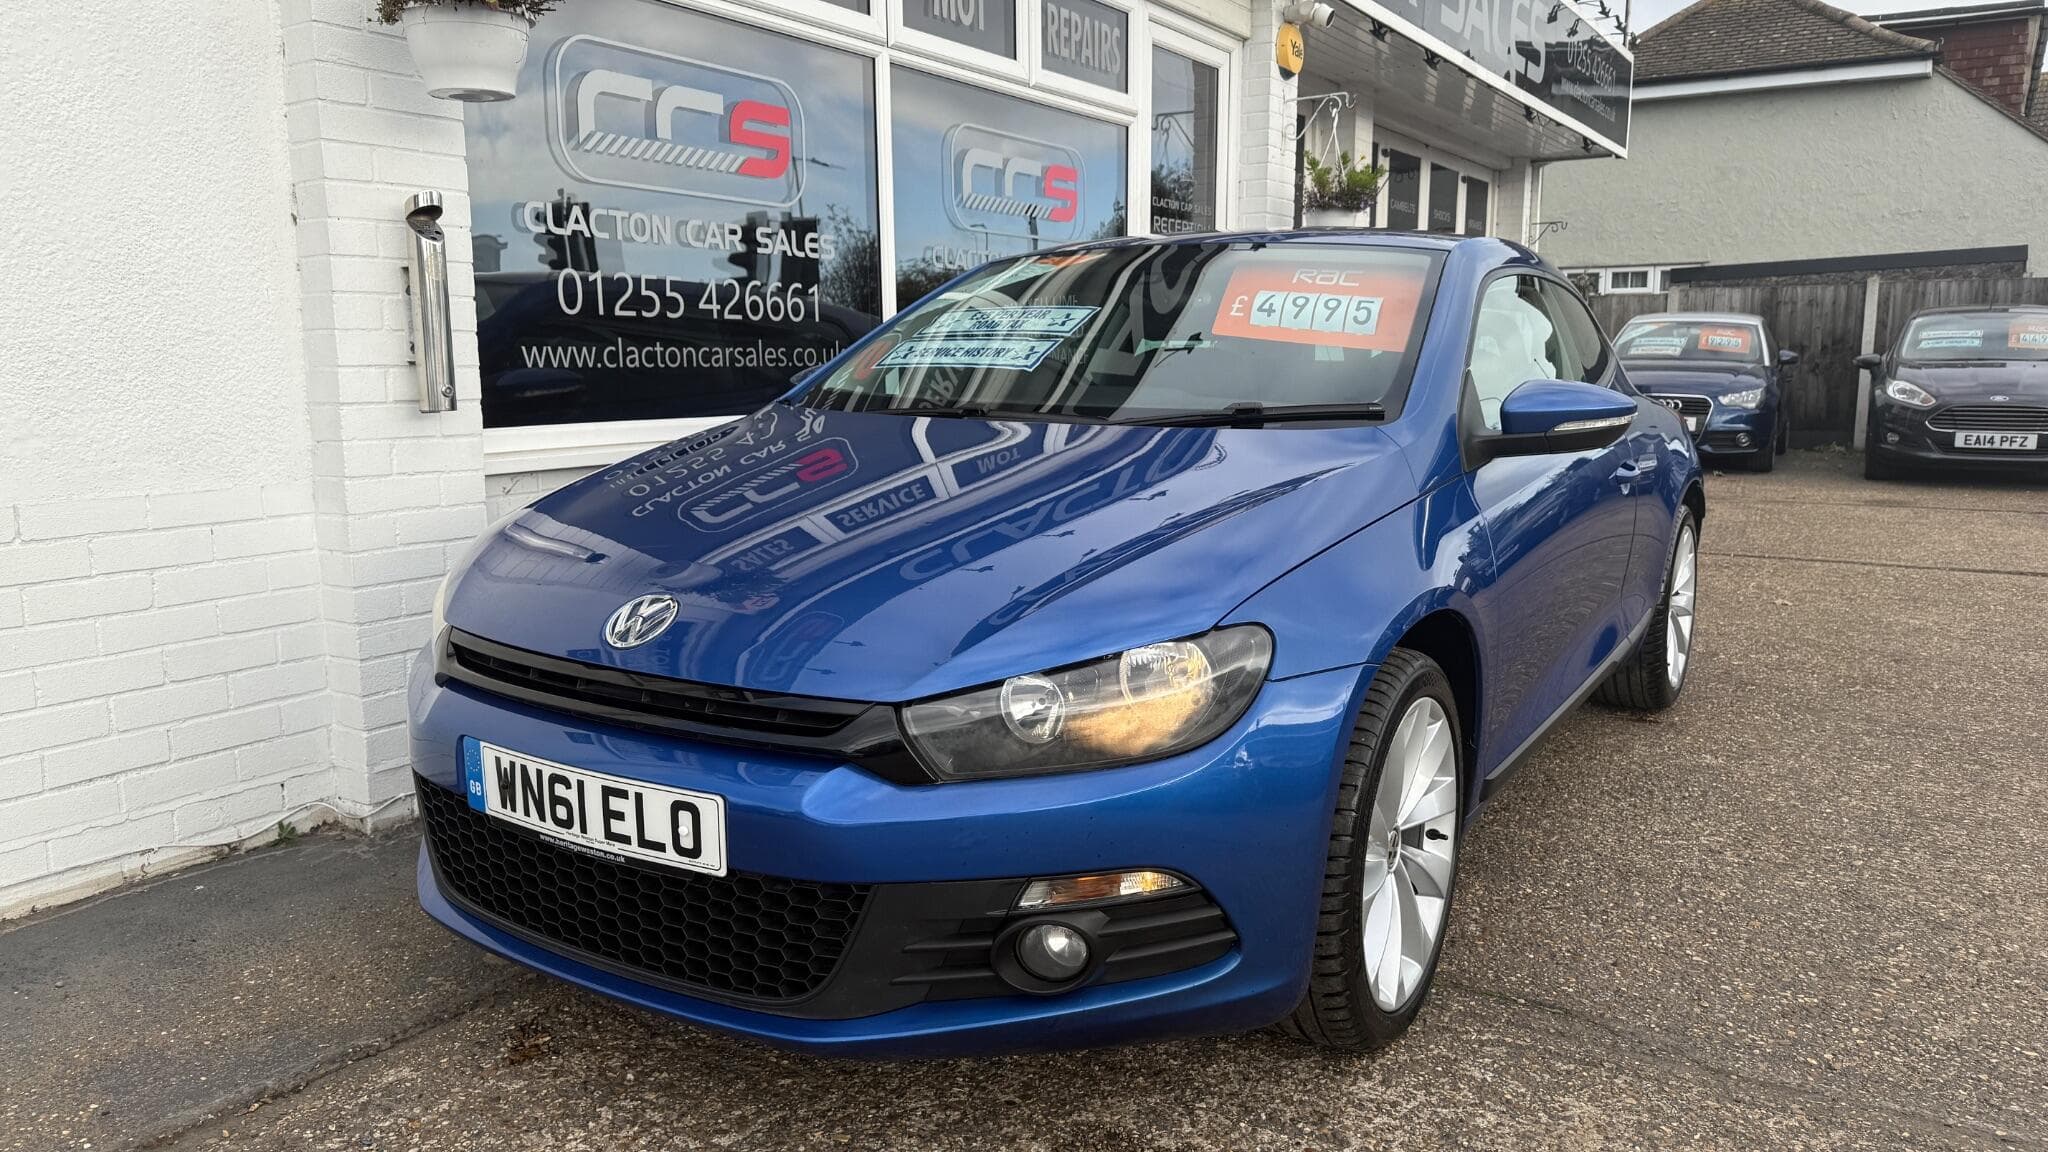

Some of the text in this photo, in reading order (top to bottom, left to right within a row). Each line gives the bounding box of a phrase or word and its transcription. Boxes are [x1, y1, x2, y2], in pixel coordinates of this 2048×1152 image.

[1047, 3, 1121, 73] REPAIRS
[577, 69, 790, 179] CCS
[962, 148, 1078, 222] CCS
[1152, 196, 1179, 210] CLACTON
[524, 201, 835, 260] CLACTON CAR SALES
[1292, 268, 1364, 287] RAC
[557, 268, 820, 322] 01255 426661
[994, 311, 1016, 320] PER
[1018, 310, 1051, 319] YEAR
[969, 320, 1028, 330] ROAD TAX
[959, 346, 1014, 358] HISTORY
[1964, 434, 2028, 447] EA14 PFZ
[469, 780, 482, 796] GB
[494, 755, 702, 859] WN61 ELO
